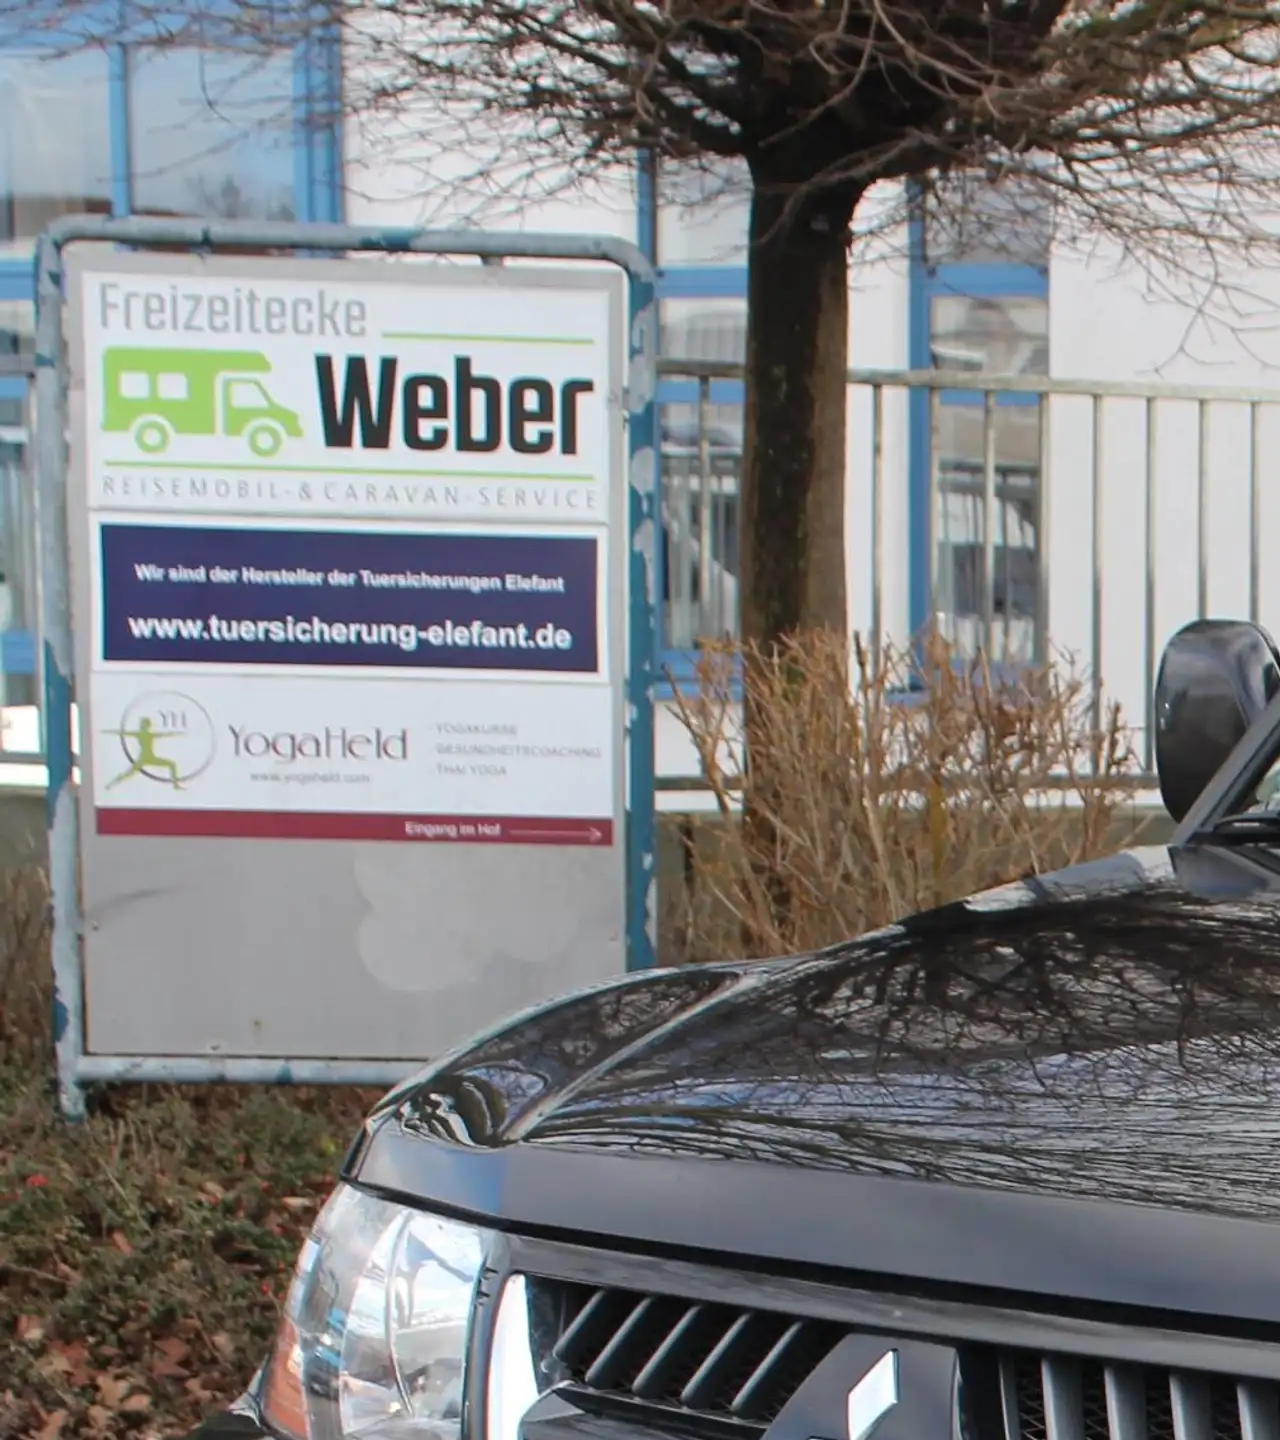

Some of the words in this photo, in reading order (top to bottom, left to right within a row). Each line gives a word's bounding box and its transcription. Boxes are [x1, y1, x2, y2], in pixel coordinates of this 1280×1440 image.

[99, 282, 367, 338] Freizeitecke
[314, 352, 595, 455] Weber
[134, 563, 166, 582] Wir
[168, 564, 206, 584] sind
[209, 566, 239, 584] der
[242, 566, 325, 587] Hersteller
[327, 569, 356, 587] der
[359, 568, 501, 594] Tuersicherungen
[505, 573, 565, 593] Elefant
[127, 614, 573, 651] www.tuersicherung-elefant.de
[228, 723, 409, 763] YogaHeld
[405, 820, 457, 839] Eingang
[459, 822, 476, 836] im
[478, 822, 501, 837] Hof
